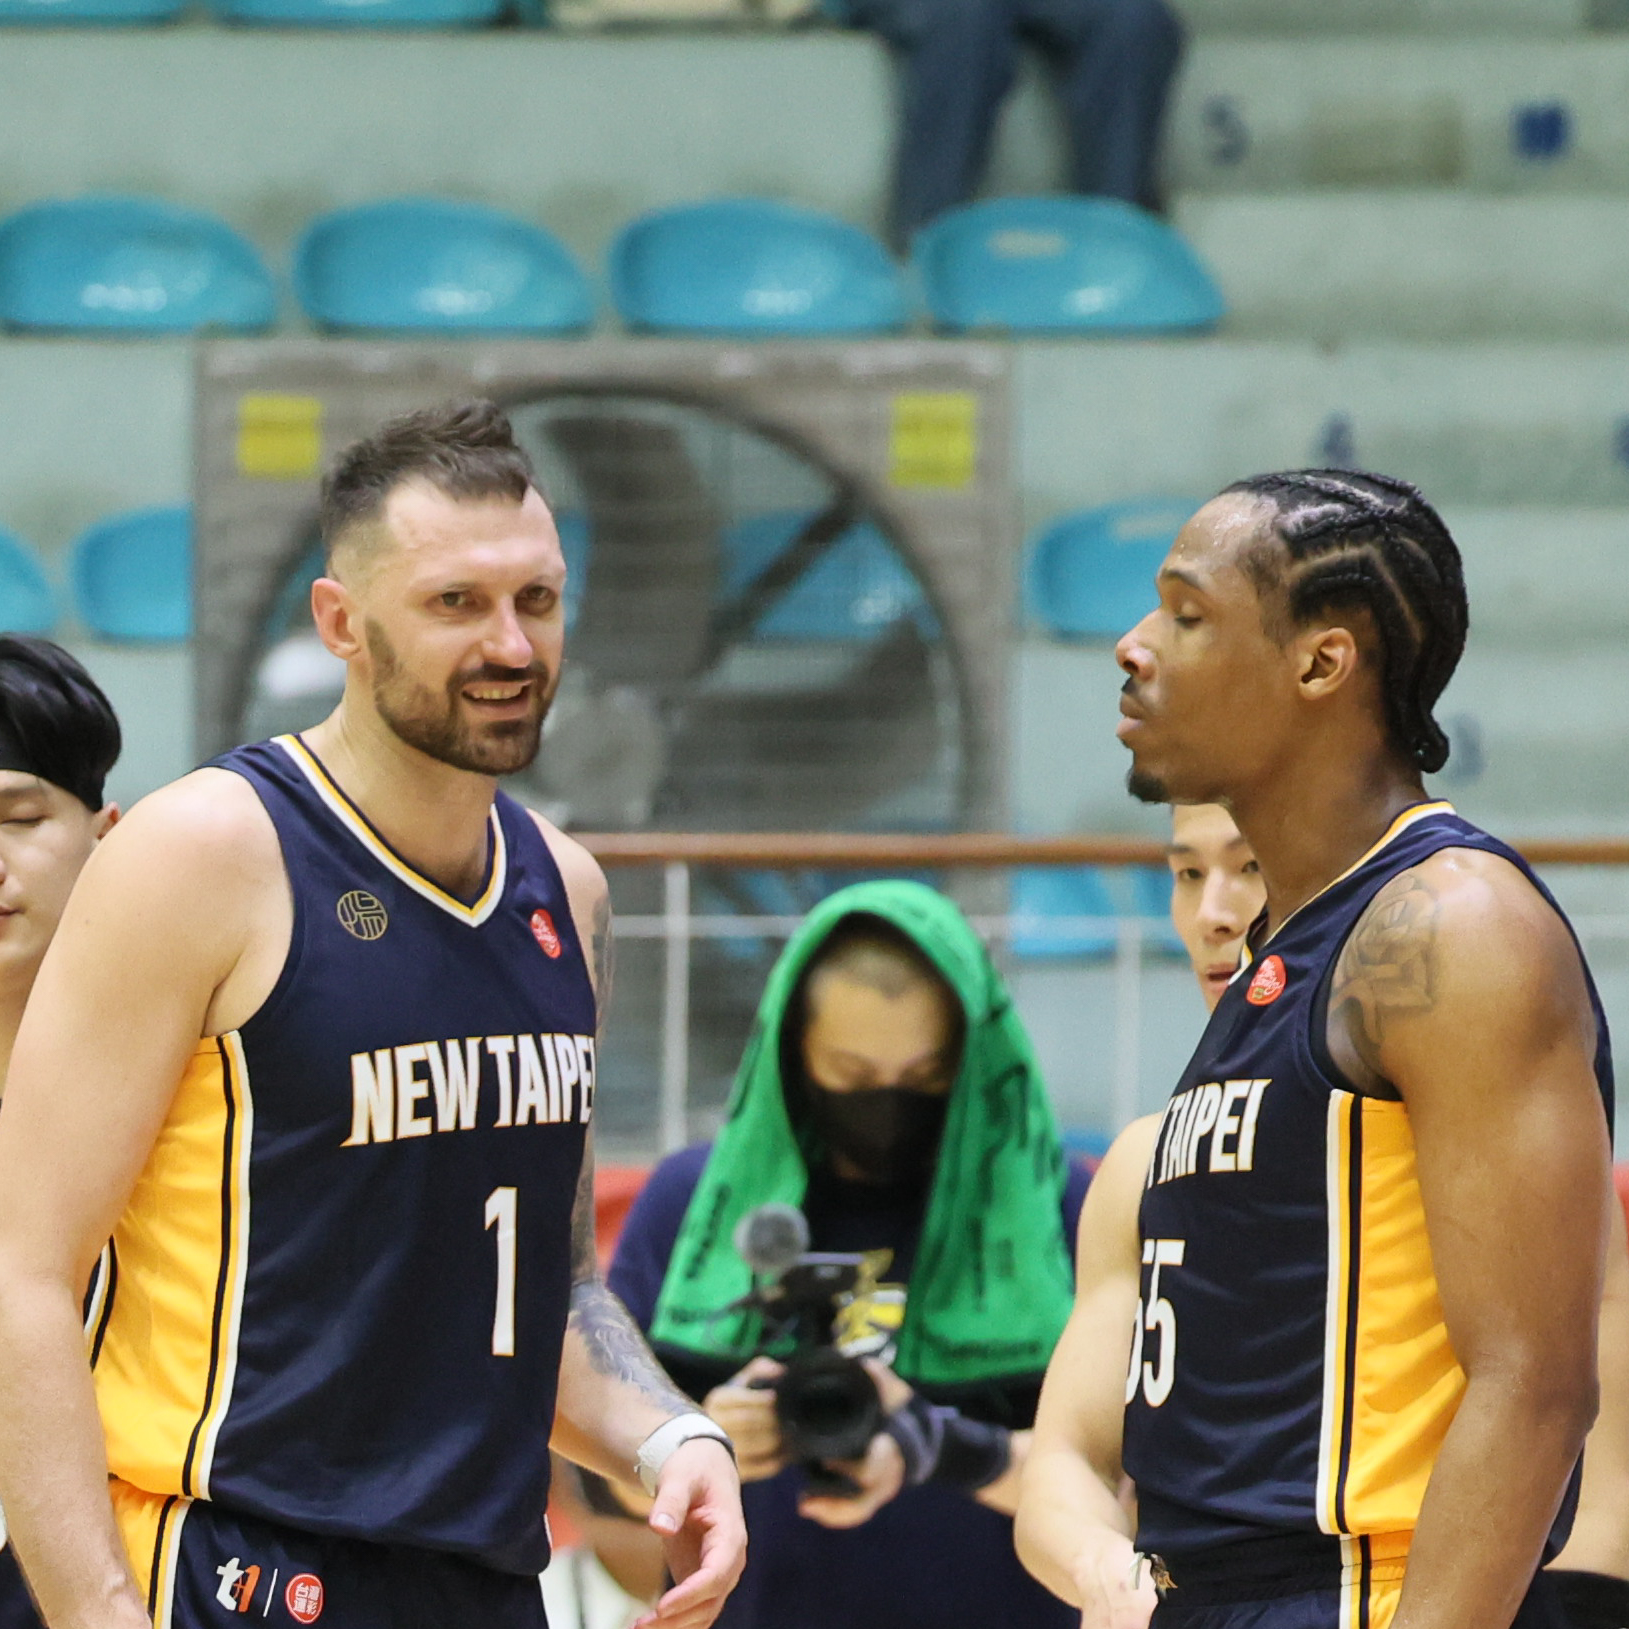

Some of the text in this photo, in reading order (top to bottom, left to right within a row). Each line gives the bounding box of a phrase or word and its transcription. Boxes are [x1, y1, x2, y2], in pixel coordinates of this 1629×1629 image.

[336, 1033, 596, 1147] NEW TAIPE
[484, 1186, 518, 1357] 1
